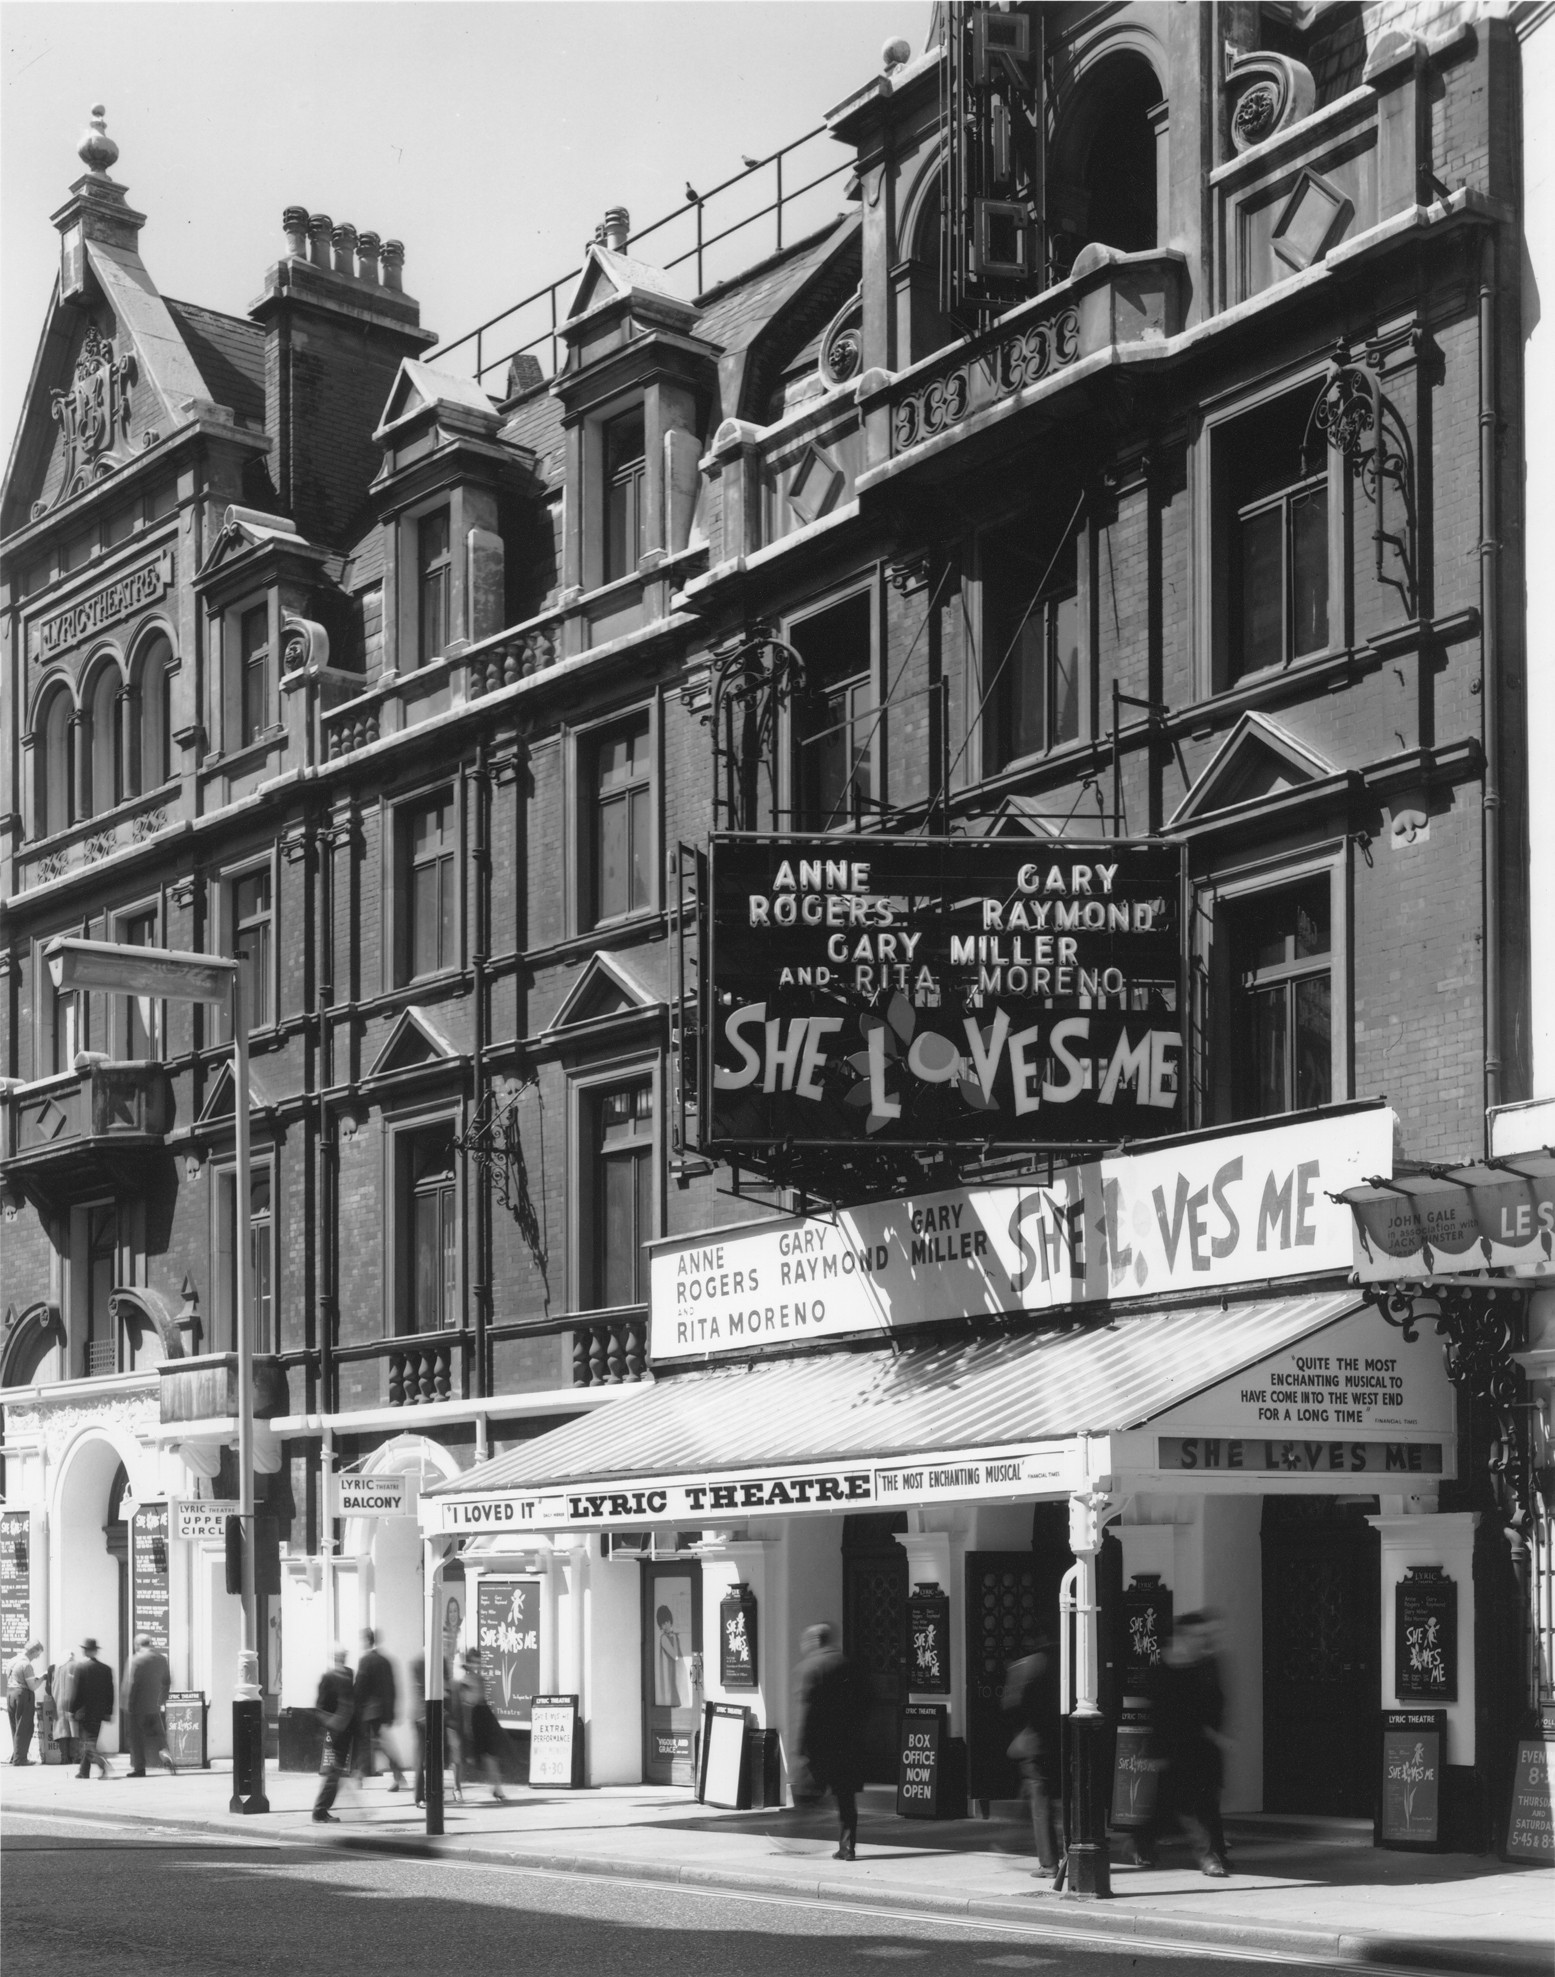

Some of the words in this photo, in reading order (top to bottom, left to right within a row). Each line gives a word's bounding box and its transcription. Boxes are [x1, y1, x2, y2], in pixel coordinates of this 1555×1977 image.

[48, 609, 88, 651] LYRIC
[88, 567, 157, 626] THEATRE
[772, 859, 872, 894] ANNE
[1017, 862, 1119, 896] GARY
[748, 894, 894, 928] ROGERS
[983, 900, 1153, 933] RAYMOND
[828, 931, 922, 964] GARY
[950, 935, 1078, 966] MILLER
[779, 966, 831, 986] AND
[856, 964, 935, 993] RITA
[978, 966, 1123, 996] MORENO
[713, 1002, 844, 1101] SHE
[1098, 1025, 1183, 1109] ME
[911, 1203, 963, 1234] GARY
[1008, 1190, 1087, 1293] SHE
[1256, 1158, 1321, 1252] ME
[1388, 1213, 1421, 1228] JOHN
[1427, 1208, 1456, 1223] GALE
[1388, 1231, 1395, 1239] in
[1400, 1223, 1456, 1238] association
[1460, 1219, 1479, 1230] with
[779, 1227, 828, 1256] GARY
[911, 1230, 988, 1265] MILLER
[1388, 1238, 1415, 1249] JACK
[1421, 1230, 1464, 1245] MINSTER
[677, 1247, 725, 1276] ANNE
[780, 1245, 889, 1286] RAYMOND
[677, 1269, 759, 1304] ROGERS
[677, 1317, 721, 1344] RITA
[729, 1300, 826, 1336] MORENO
[1336, 1357, 1359, 1371] THE
[1365, 1358, 1397, 1372] MOST
[1270, 1373, 1340, 1388] ENCHANTING
[1345, 1375, 1387, 1389] MUSICAL
[1389, 1376, 1403, 1389] TO
[1241, 1390, 1267, 1403] HAVE
[1270, 1390, 1298, 1404] COME
[1328, 1392, 1348, 1405] THE
[1351, 1392, 1379, 1406] WEST
[1382, 1392, 1403, 1406] END
[1258, 1408, 1280, 1421] FOR
[1283, 1408, 1292, 1421] A
[1297, 1409, 1330, 1423] LONG
[1181, 1438, 1243, 1470] SHE
[1385, 1444, 1422, 1471] ME
[341, 1479, 374, 1490] LYRIC
[902, 1472, 924, 1490] MOST
[929, 1467, 980, 1488] ENCHANTING
[343, 1496, 402, 1509] BALCONY
[569, 1490, 667, 1519] LYRIC
[685, 1474, 871, 1511] THEATRE
[180, 1505, 206, 1513] LYRIC
[464, 1504, 514, 1523] LOVED
[184, 1516, 223, 1525] UPPE
[181, 1527, 225, 1535] CIRCL
[1415, 1572, 1437, 1580] LYRIC
[1130, 1616, 1143, 1633] SHE
[481, 1627, 497, 1647] SHE
[524, 1630, 538, 1649] ME
[913, 1632, 926, 1648] SHE
[1406, 1627, 1424, 1645] SHE
[1149, 1649, 1161, 1667] ME
[930, 1662, 940, 1676] ME
[1430, 1663, 1446, 1683] ME
[540, 1725, 565, 1733] EXTRA
[1389, 1715, 1406, 1723] LYRIC
[1408, 1715, 1435, 1724] THEATRE
[908, 1734, 931, 1748] BOX
[902, 1750, 935, 1765] OFFICE
[906, 1768, 931, 1782] NOW
[1387, 1765, 1402, 1779] SHE
[1424, 1768, 1434, 1781] ME
[903, 1784, 931, 1799] OPEN
